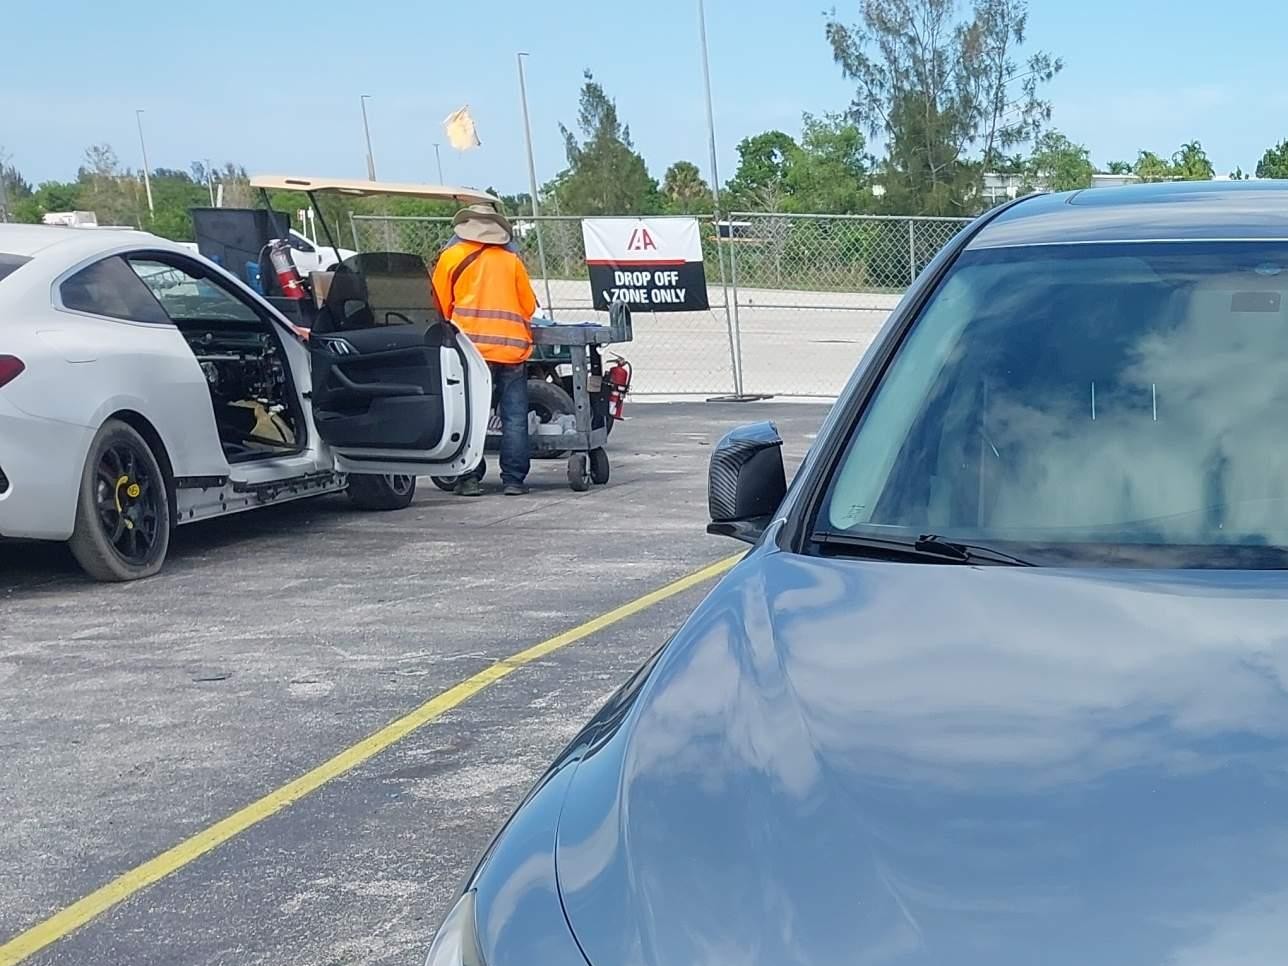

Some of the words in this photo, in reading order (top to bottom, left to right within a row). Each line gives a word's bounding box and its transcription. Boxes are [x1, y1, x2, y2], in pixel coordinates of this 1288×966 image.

[614, 271, 651, 287] DROP
[654, 271, 679, 286] OFF
[610, 288, 649, 303] ZONE
[651, 288, 686, 303] ONLY
